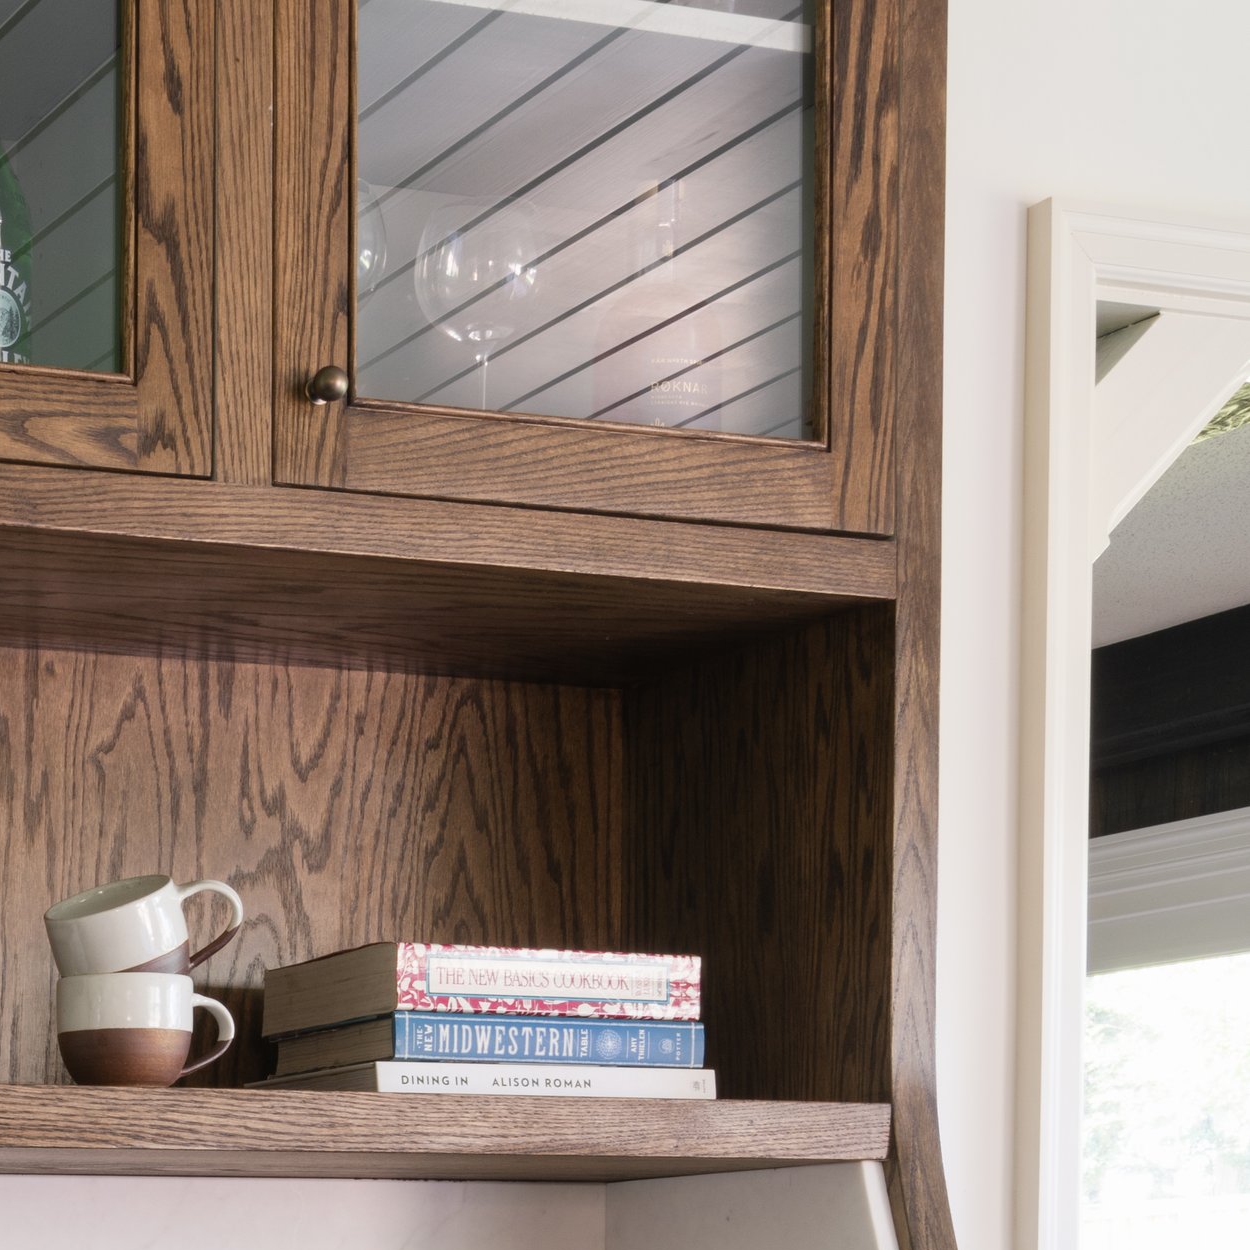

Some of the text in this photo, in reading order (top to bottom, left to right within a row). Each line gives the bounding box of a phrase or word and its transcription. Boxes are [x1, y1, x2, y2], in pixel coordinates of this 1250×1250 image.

[436, 966, 464, 985] THE
[468, 968, 499, 986] NEW
[503, 969, 550, 989] BASICS
[553, 971, 630, 991] COOKBOOK
[424, 1024, 433, 1052] NEW
[438, 1023, 574, 1057] MIDWESTERN
[580, 1029, 589, 1057] TABLE
[401, 1075, 592, 1088] DINING IN ALISON ROMAN
